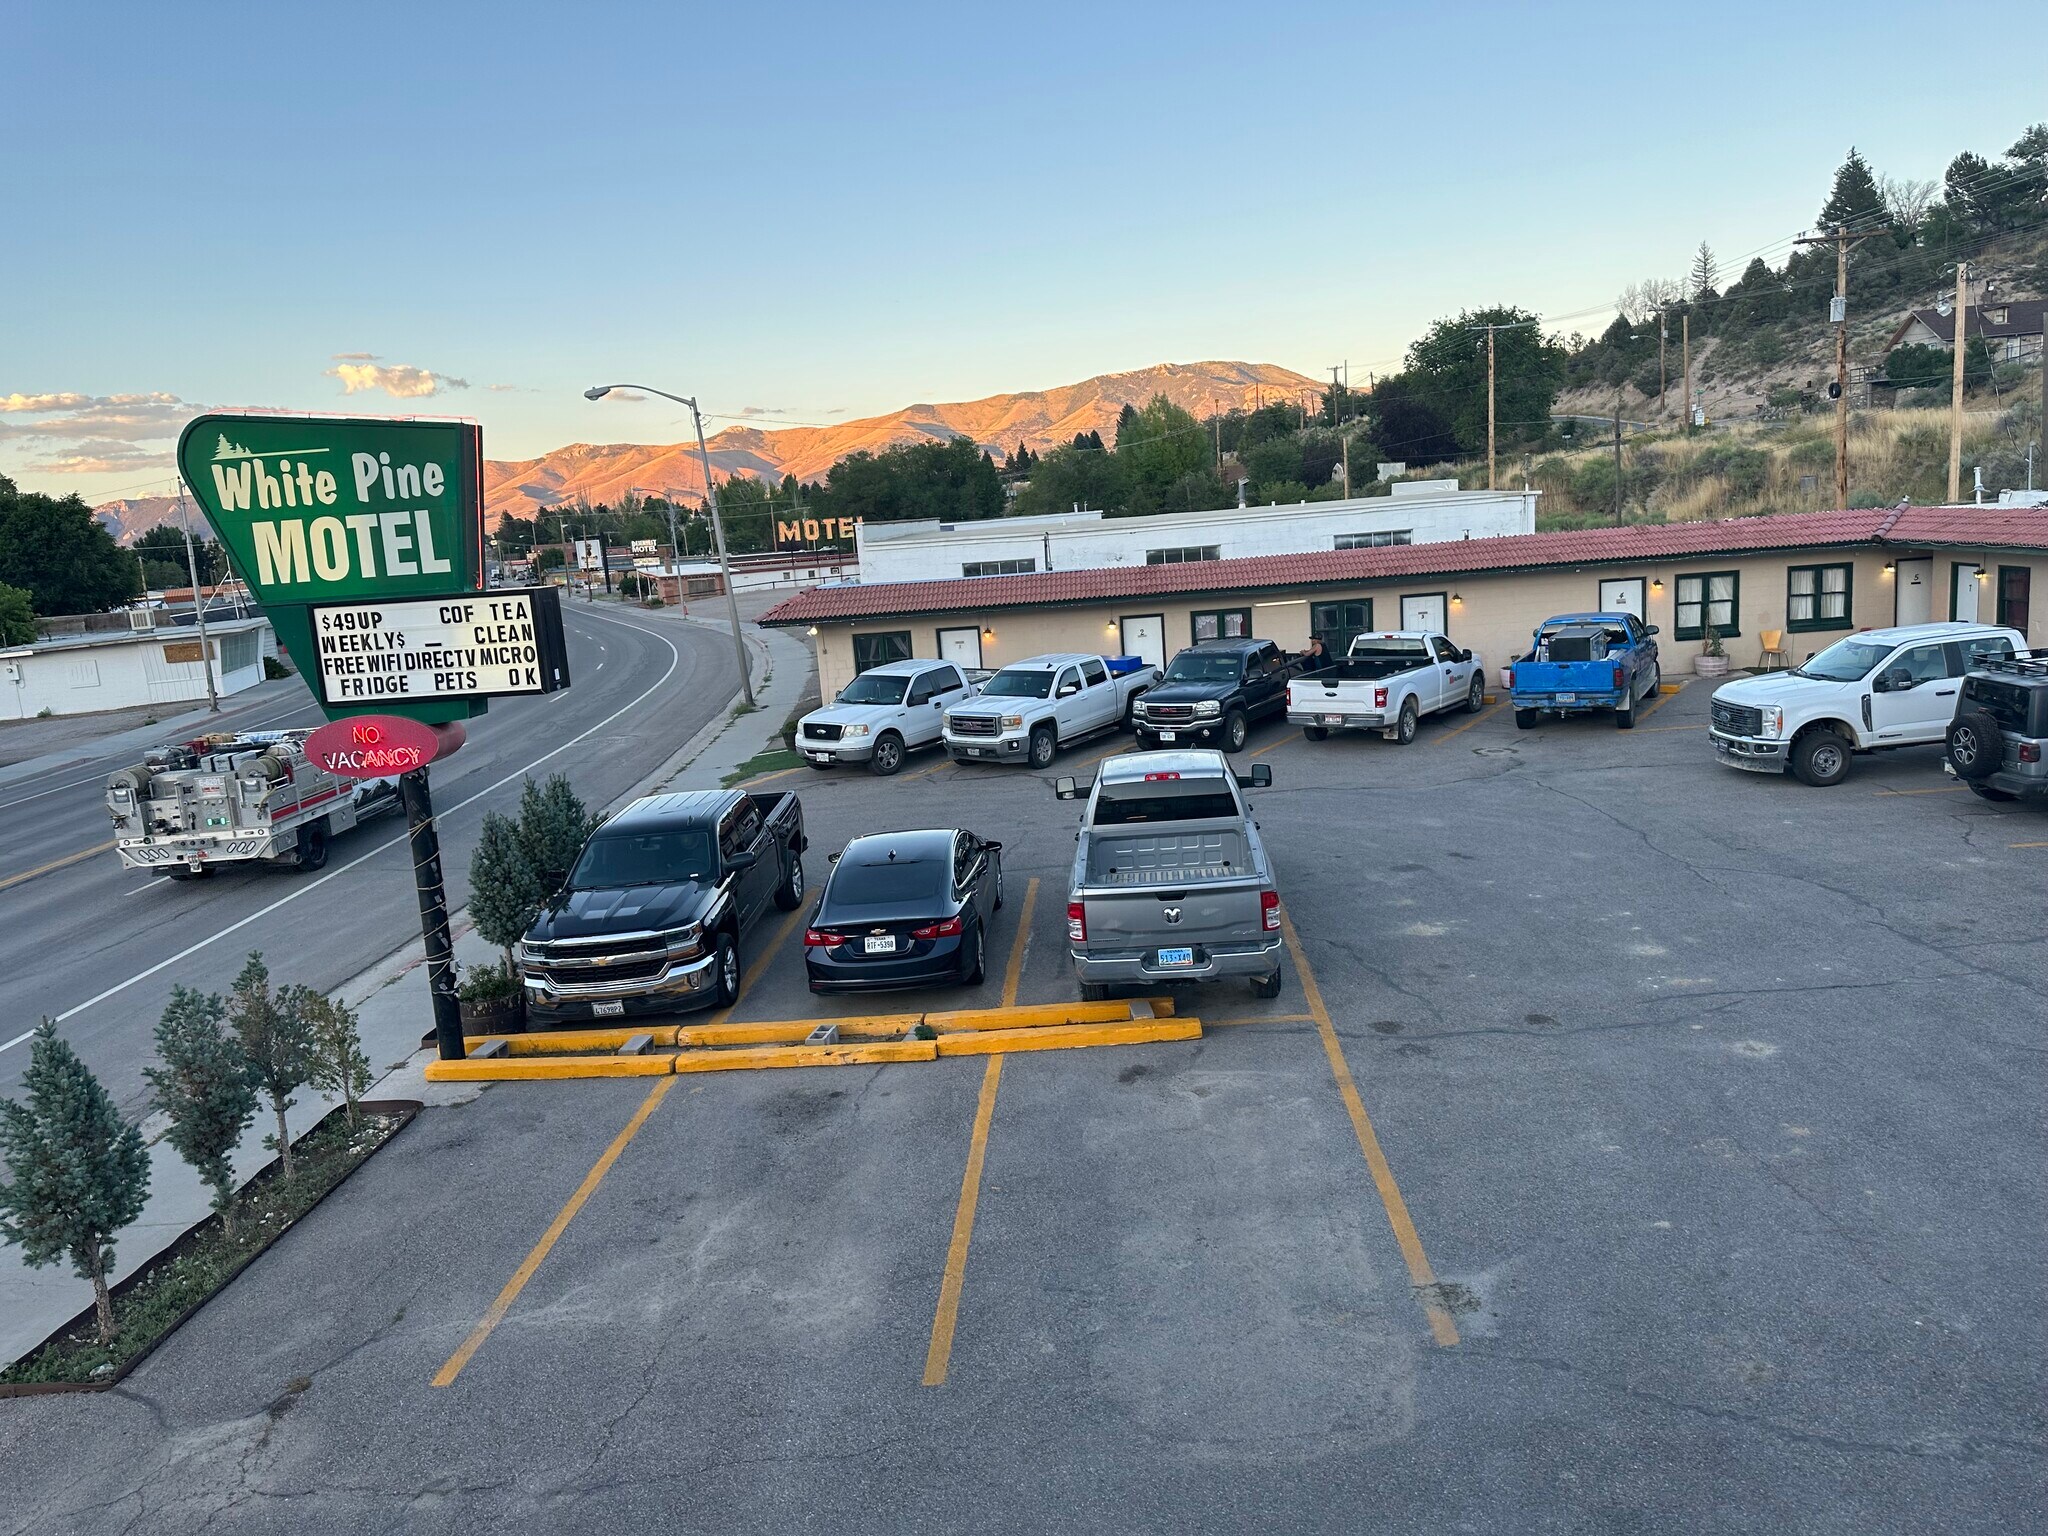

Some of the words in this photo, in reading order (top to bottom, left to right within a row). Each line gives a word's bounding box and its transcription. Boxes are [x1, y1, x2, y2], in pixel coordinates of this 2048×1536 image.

[211, 459, 337, 511] White
[352, 452, 444, 502] Pine
[778, 516, 863, 542] MOTE
[252, 510, 451, 585] MOTEL
[1913, 573, 1919, 581] 5
[439, 605, 474, 624] COF
[489, 602, 528, 621] TEA
[321, 632, 405, 653] WEEKLY$
[474, 623, 533, 644] CLEAN
[323, 656, 365, 675] FREE
[366, 653, 401, 672] WIFI
[404, 649, 475, 671] DIRECTV
[480, 646, 536, 666] MICRO
[341, 675, 409, 696] FRIDGE
[434, 671, 477, 691] PETS
[509, 668, 536, 686] OK
[352, 726, 380, 743] NO
[322, 746, 420, 769] VACANCY
